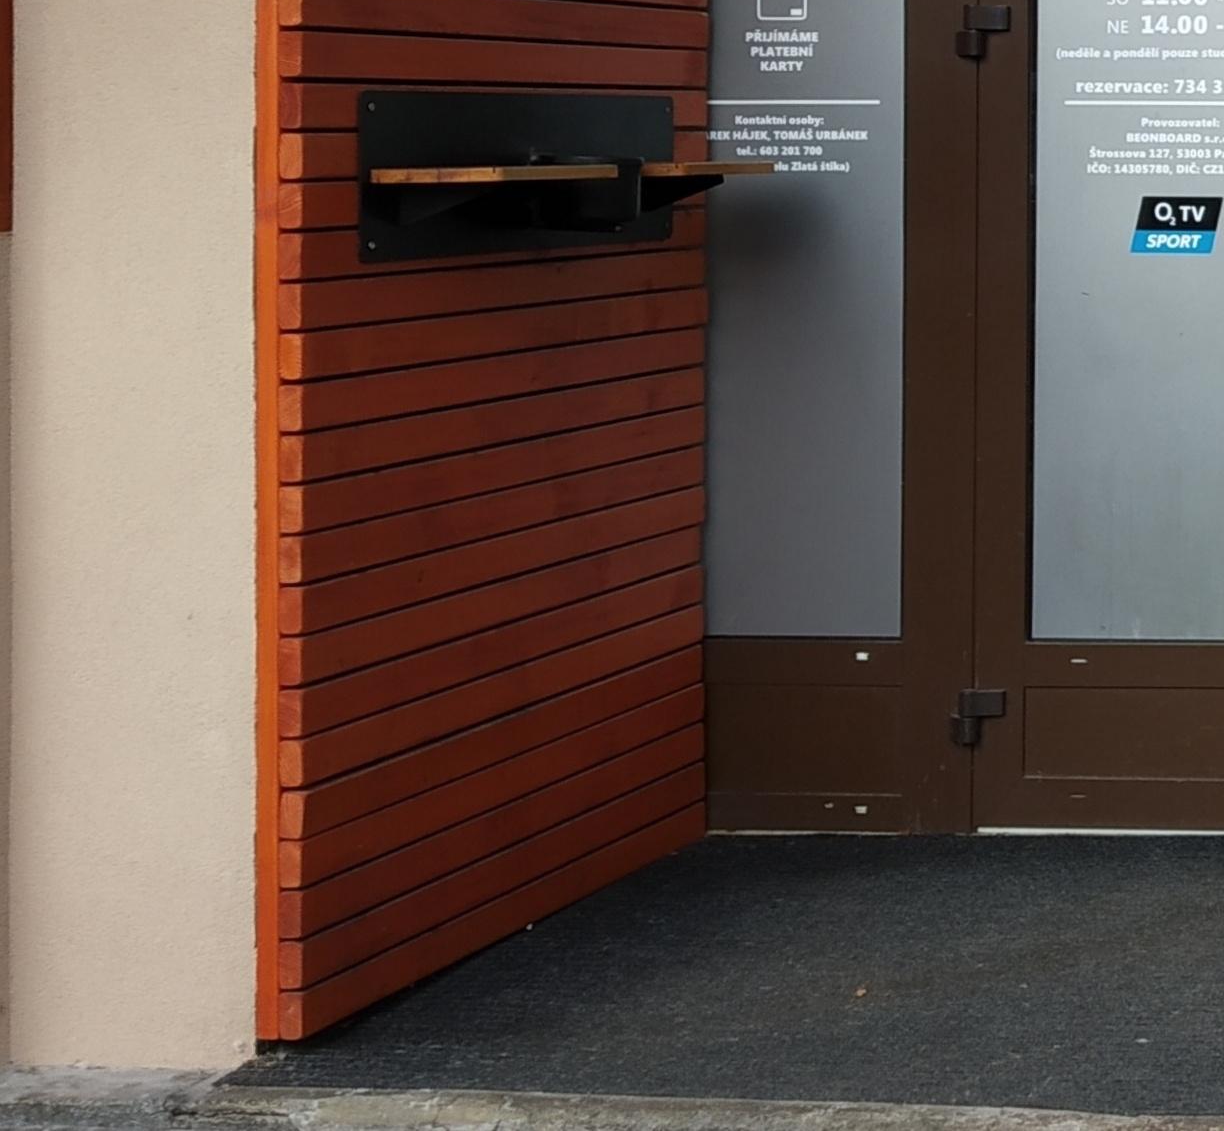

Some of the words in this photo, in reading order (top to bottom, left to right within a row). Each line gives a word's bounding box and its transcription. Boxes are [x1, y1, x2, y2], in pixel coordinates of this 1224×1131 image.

[1106, 20, 1129, 35] NE
[1140, 15, 1208, 35] 14.00
[745, 29, 819, 43] PŘIJÍMÁME
[750, 43, 814, 58] PLATEBNÍ
[1056, 47, 1101, 60] (neděle
[1103, 50, 1111, 59] a
[1113, 47, 1160, 60] pondělí
[1162, 50, 1198, 60] pouze
[760, 60, 804, 72] KARTY
[1075, 81, 1169, 95] rezervace:
[1174, 79, 1207, 95] 734
[788, 114, 825, 127] osoby:
[1141, 117, 1220, 128] Provozovatel:
[732, 129, 772, 143] HÁJEK,
[773, 128, 814, 141] TOMÁŠ
[815, 128, 869, 141] URBÁNEK
[1126, 132, 1202, 144] BEONBOARD
[736, 146, 758, 157] tel.:
[759, 146, 779, 156] 603
[781, 146, 801, 156] 201
[803, 146, 823, 156] 700
[1088, 146, 1146, 159] Štrossova
[1149, 148, 1174, 160] 127,
[1176, 148, 1212, 159] 53003
[790, 161, 818, 172] Zlatá
[1087, 161, 1112, 174] IČO:
[1114, 164, 1173, 175] 14305780,
[1176, 162, 1201, 175] DIČ:
[1178, 205, 1206, 222] TV
[1145, 234, 1202, 249] SPORT
